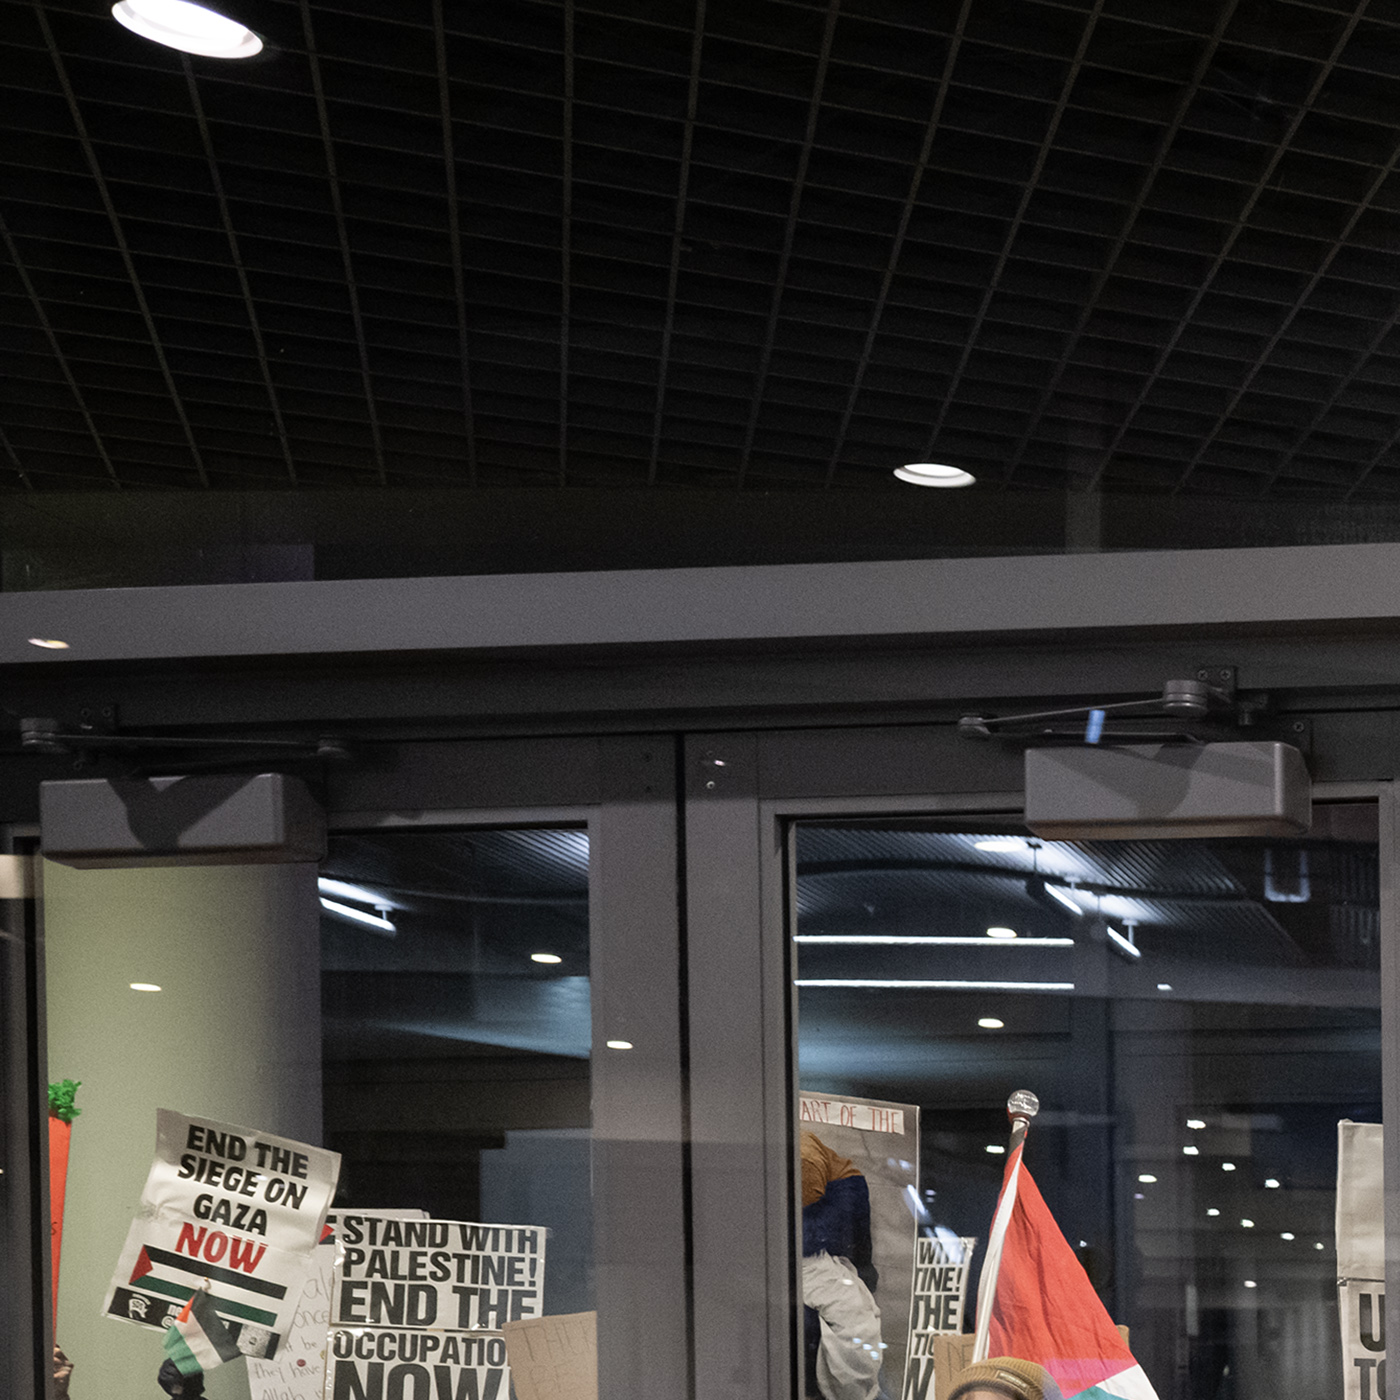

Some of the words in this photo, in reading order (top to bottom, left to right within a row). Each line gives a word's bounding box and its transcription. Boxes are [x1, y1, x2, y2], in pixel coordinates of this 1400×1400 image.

[840, 1105, 857, 1126] OF
[868, 1108, 899, 1133] THE
[187, 1124, 246, 1162] END
[254, 1141, 309, 1180] THE
[177, 1153, 259, 1197] SIEGE
[265, 1178, 308, 1210] ON
[193, 1193, 267, 1236] GAZA
[343, 1215, 449, 1248] STAND
[459, 1224, 538, 1254] WITH
[175, 1222, 268, 1274] NOW
[342, 1247, 537, 1287] PALESTINE!
[340, 1280, 438, 1326] END
[452, 1285, 538, 1330] THE
[332, 1330, 507, 1367] OCCUPATIO
[254, 1362, 285, 1383] they
[289, 1363, 321, 1378] have
